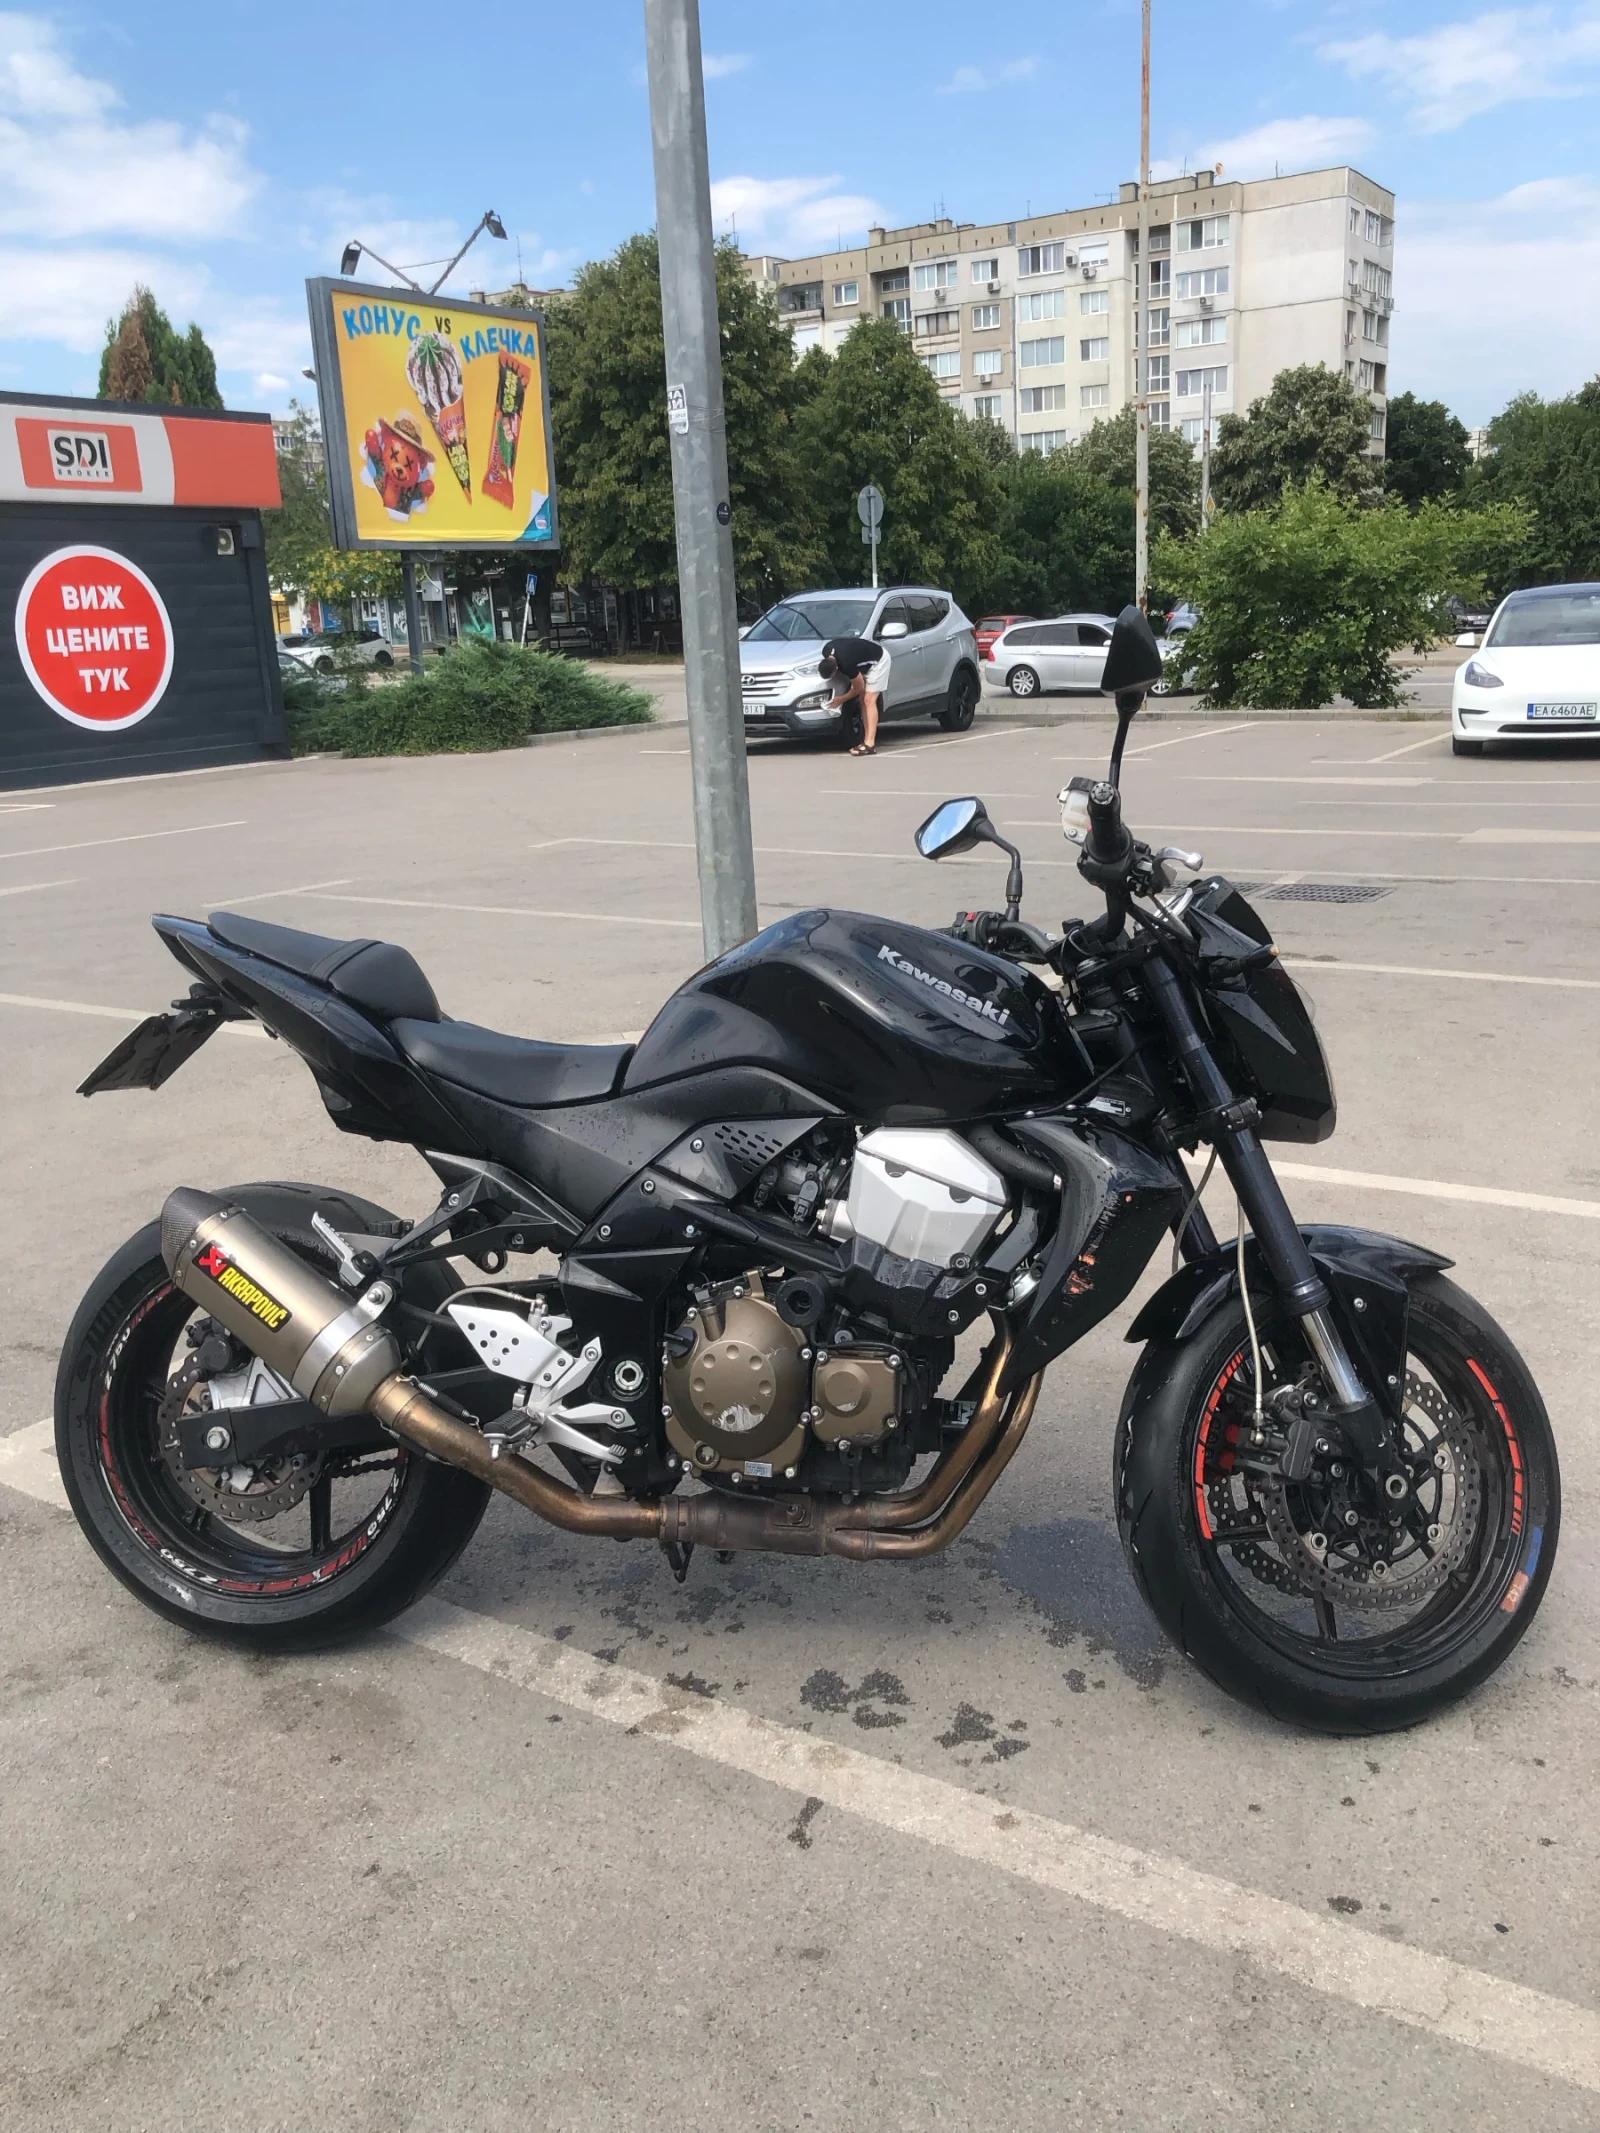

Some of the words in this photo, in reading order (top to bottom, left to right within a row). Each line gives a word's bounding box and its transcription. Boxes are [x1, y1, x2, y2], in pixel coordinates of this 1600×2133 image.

[342, 304, 421, 341] КОНУС
[460, 326, 536, 363] КЛЕЧКА
[54, 436, 108, 469] SDI
[58, 468, 110, 478] BROKER
[61, 584, 125, 611] ВИЖ
[46, 626, 150, 658] ЦЕНИТЕ
[79, 668, 131, 693] ТУК
[1534, 705, 1549, 716] EA
[1550, 705, 1577, 716] 6460
[1579, 705, 1594, 716] AE
[877, 945, 1011, 1026] Kawasaki
